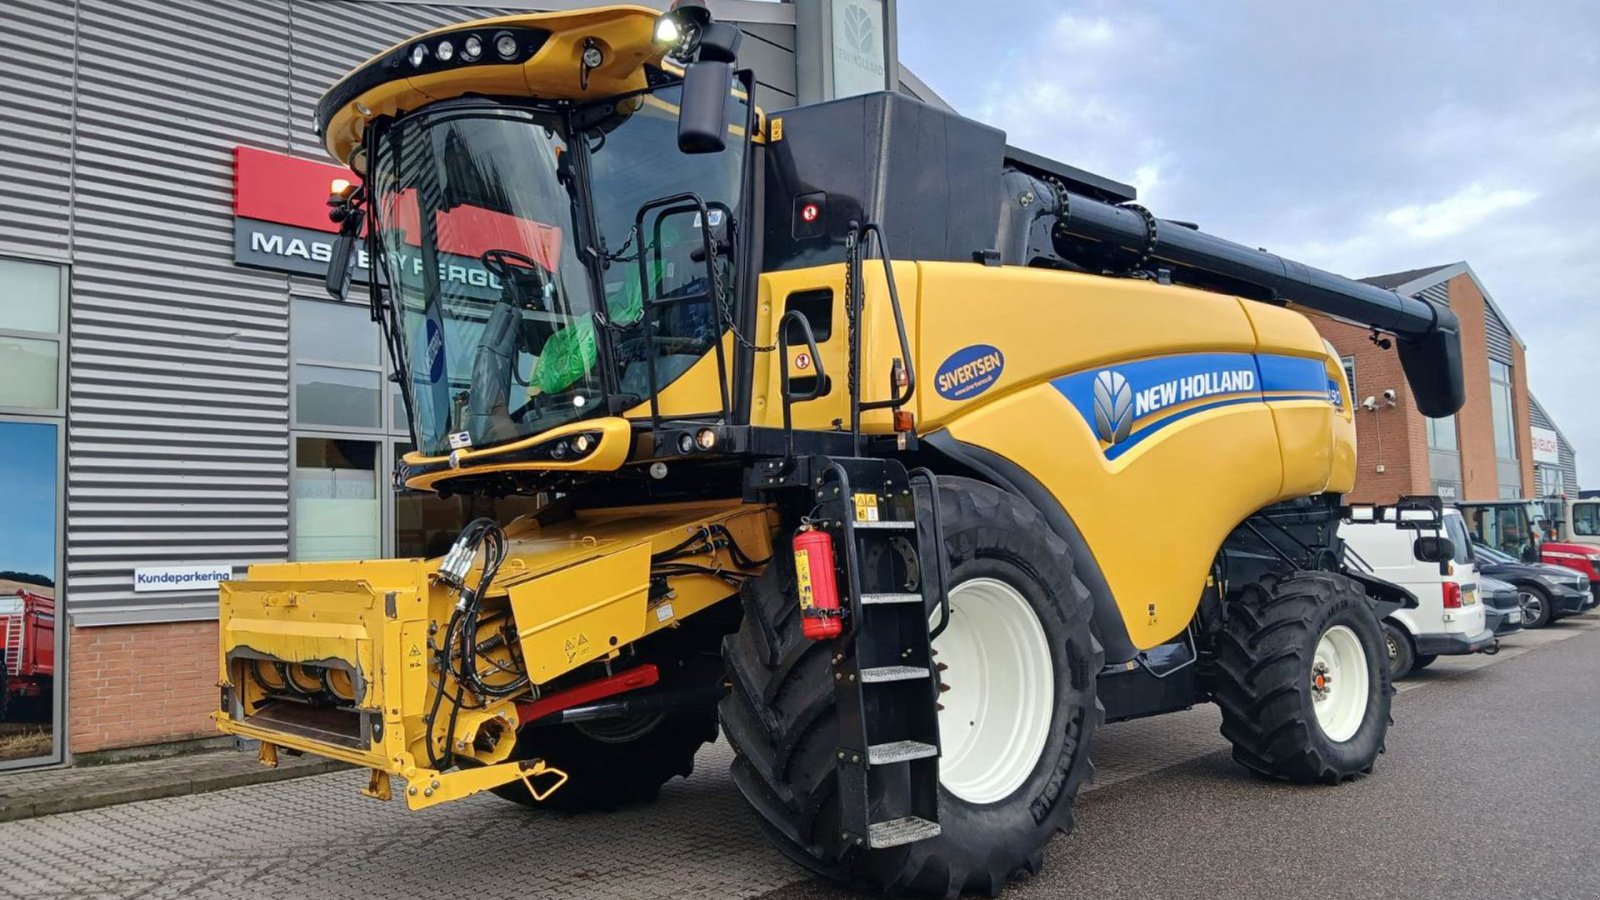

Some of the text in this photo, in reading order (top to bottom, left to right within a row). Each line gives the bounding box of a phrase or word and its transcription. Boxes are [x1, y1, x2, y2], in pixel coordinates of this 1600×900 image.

[938, 351, 1001, 392] SIVERTSEN
[1135, 369, 1256, 417] NEW HOLLAND
[137, 570, 230, 584] Kundeparkering
